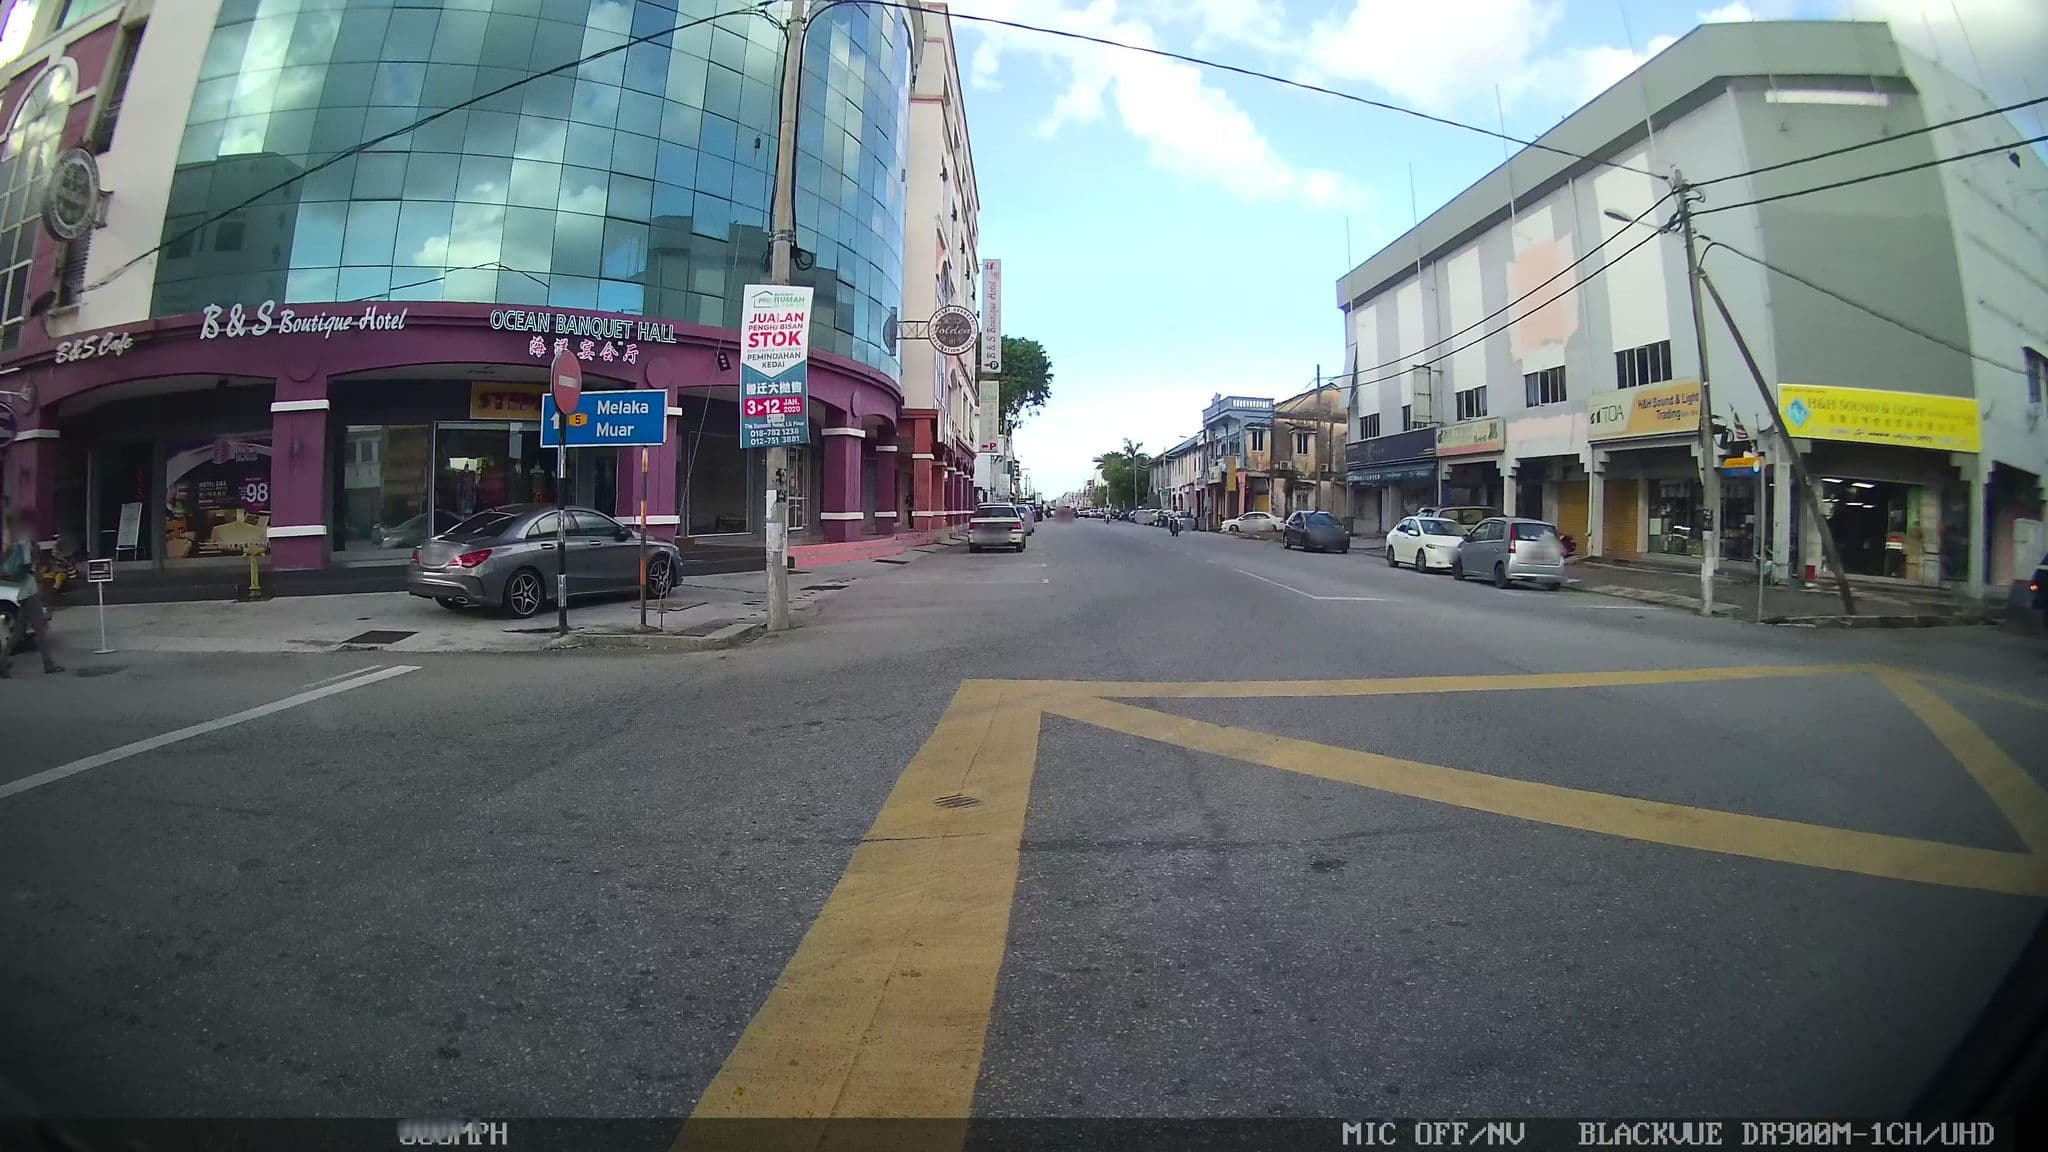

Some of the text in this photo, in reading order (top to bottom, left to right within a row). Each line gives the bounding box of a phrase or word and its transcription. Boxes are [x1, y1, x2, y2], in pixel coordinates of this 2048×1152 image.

[200, 299, 408, 339] B & S Boutique Hotel
[749, 312, 804, 324] JUALAN
[490, 309, 677, 344] OCEAN BANQUET HALL
[748, 330, 802, 348] STOK
[748, 352, 800, 360] PEMINDAHAN
[597, 400, 649, 415] Melaka
[747, 398, 800, 414] 3 12 JAN.
[1602, 404, 1624, 422] TOA
[574, 415, 581, 425] 5
[1656, 409, 1681, 420] Trading
[596, 422, 635, 437] Muar
[246, 482, 268, 502] 98
